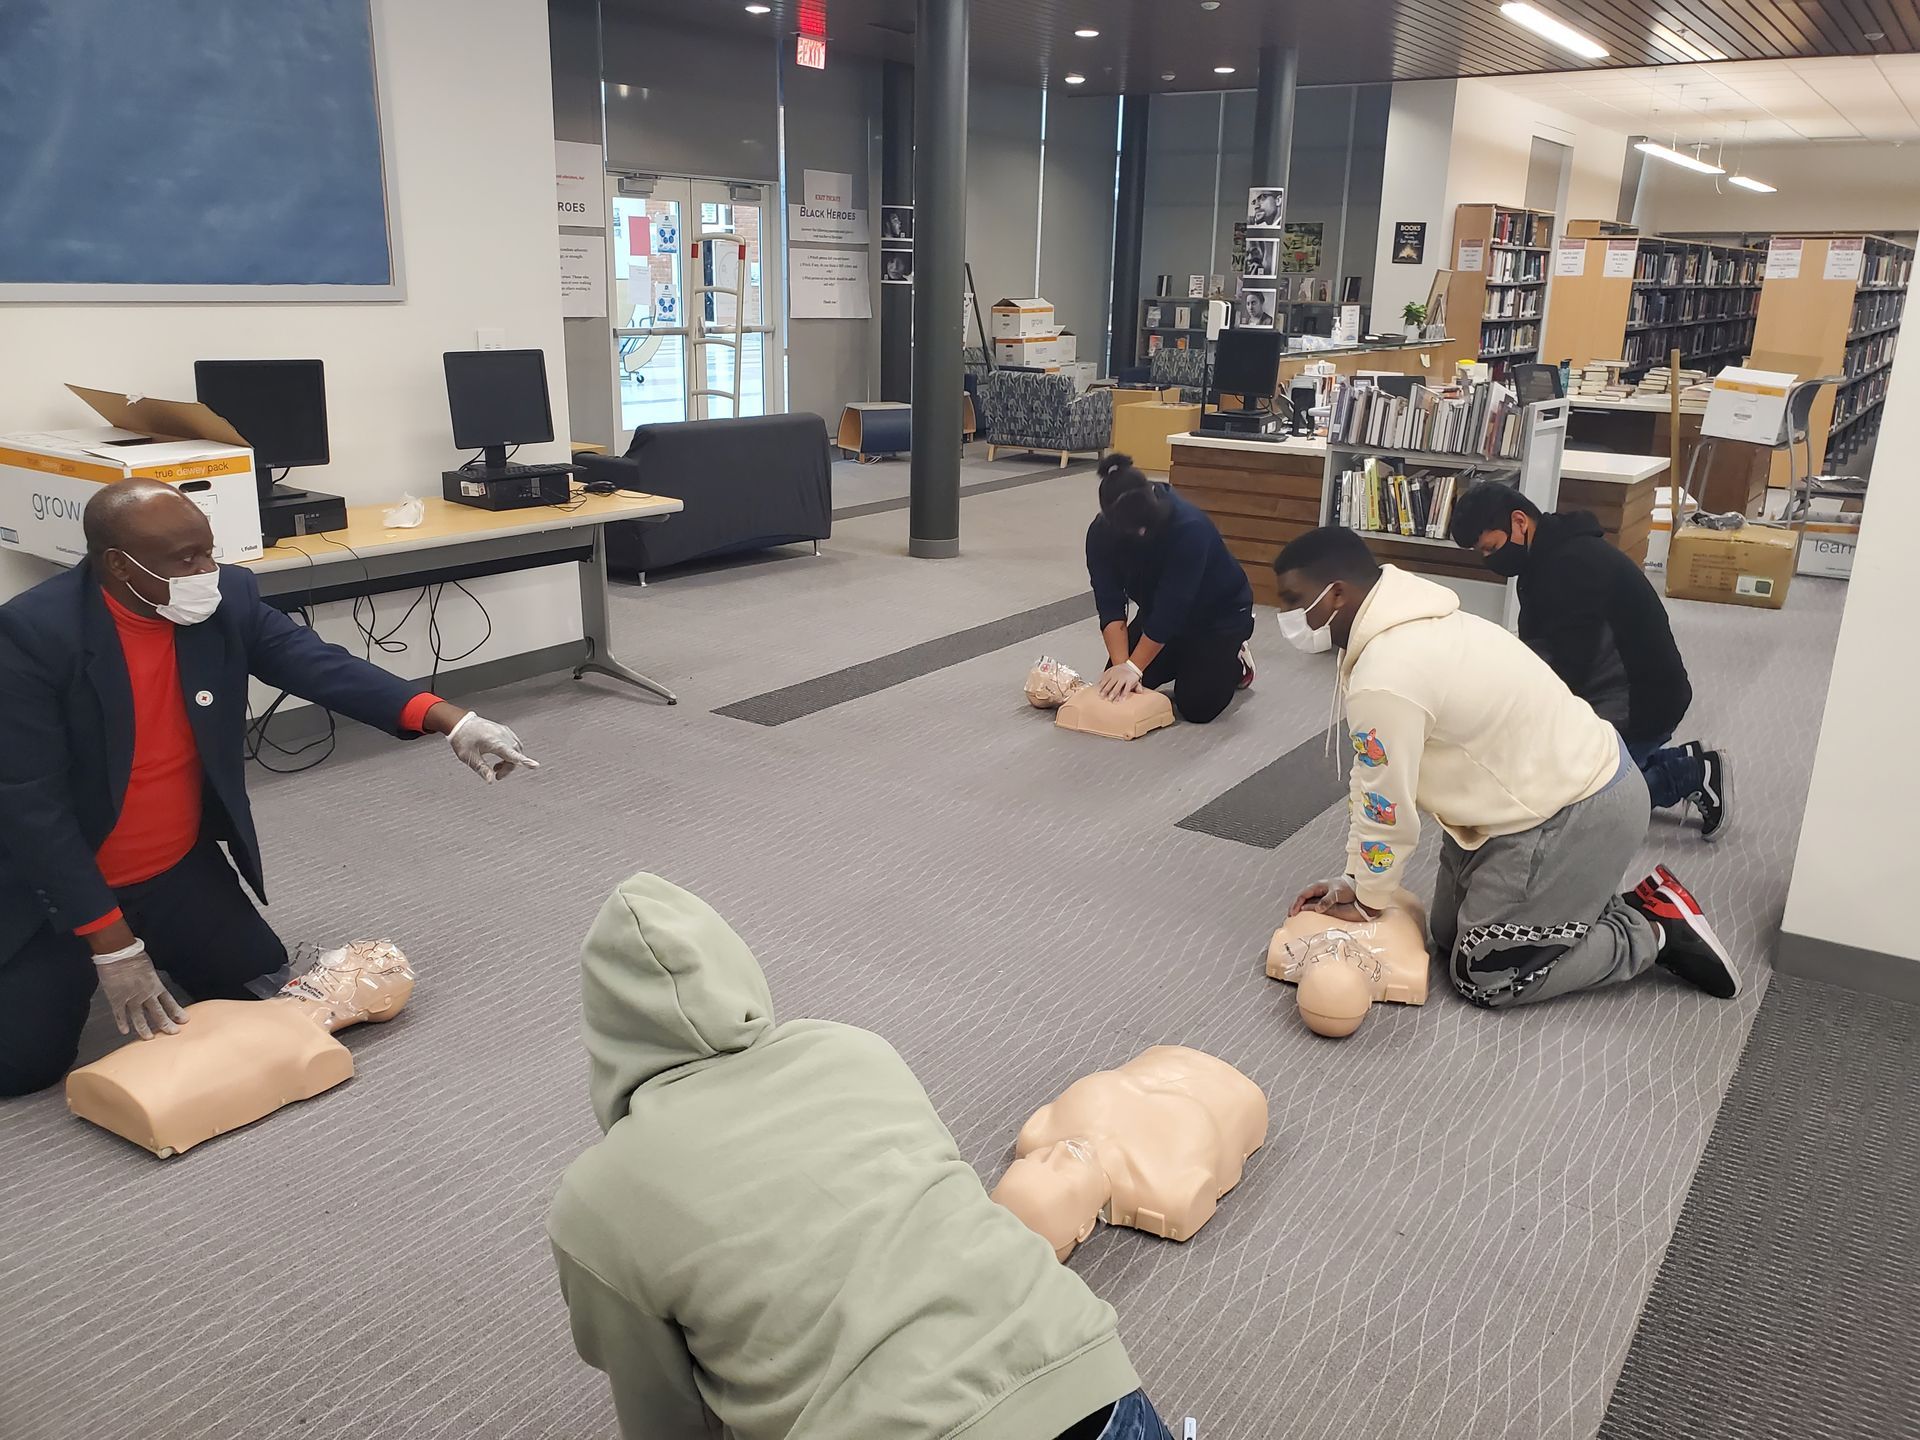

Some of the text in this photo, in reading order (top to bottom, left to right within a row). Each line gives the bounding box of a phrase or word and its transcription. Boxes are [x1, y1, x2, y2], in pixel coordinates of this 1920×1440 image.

[800, 206, 857, 221] BLACK HEROES
[155, 461, 229, 479] true dewey pack
[32, 493, 81, 521] grow
